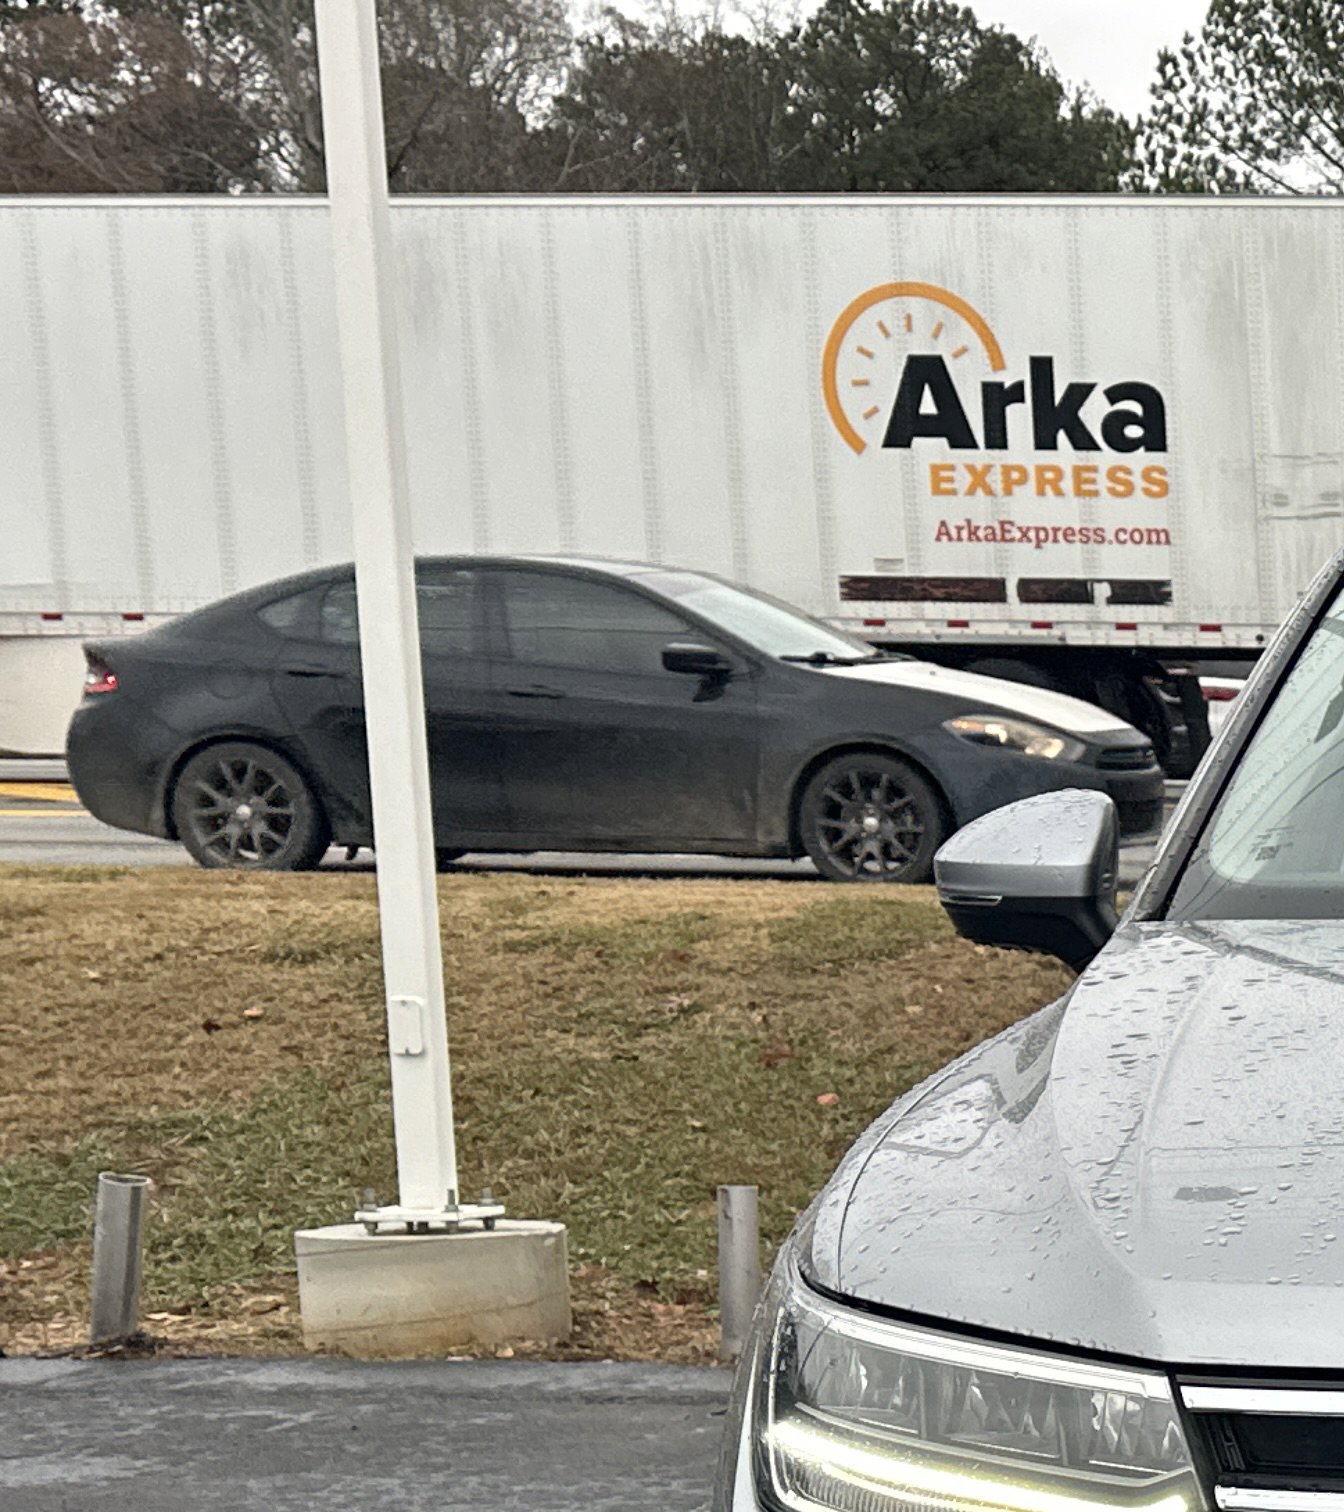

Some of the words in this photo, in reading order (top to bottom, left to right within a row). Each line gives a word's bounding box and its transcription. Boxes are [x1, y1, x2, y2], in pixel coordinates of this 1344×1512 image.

[882, 354, 1168, 452] Arka
[929, 463, 1169, 498] EXPRESS
[934, 520, 1171, 548] ArkaExpress.com
